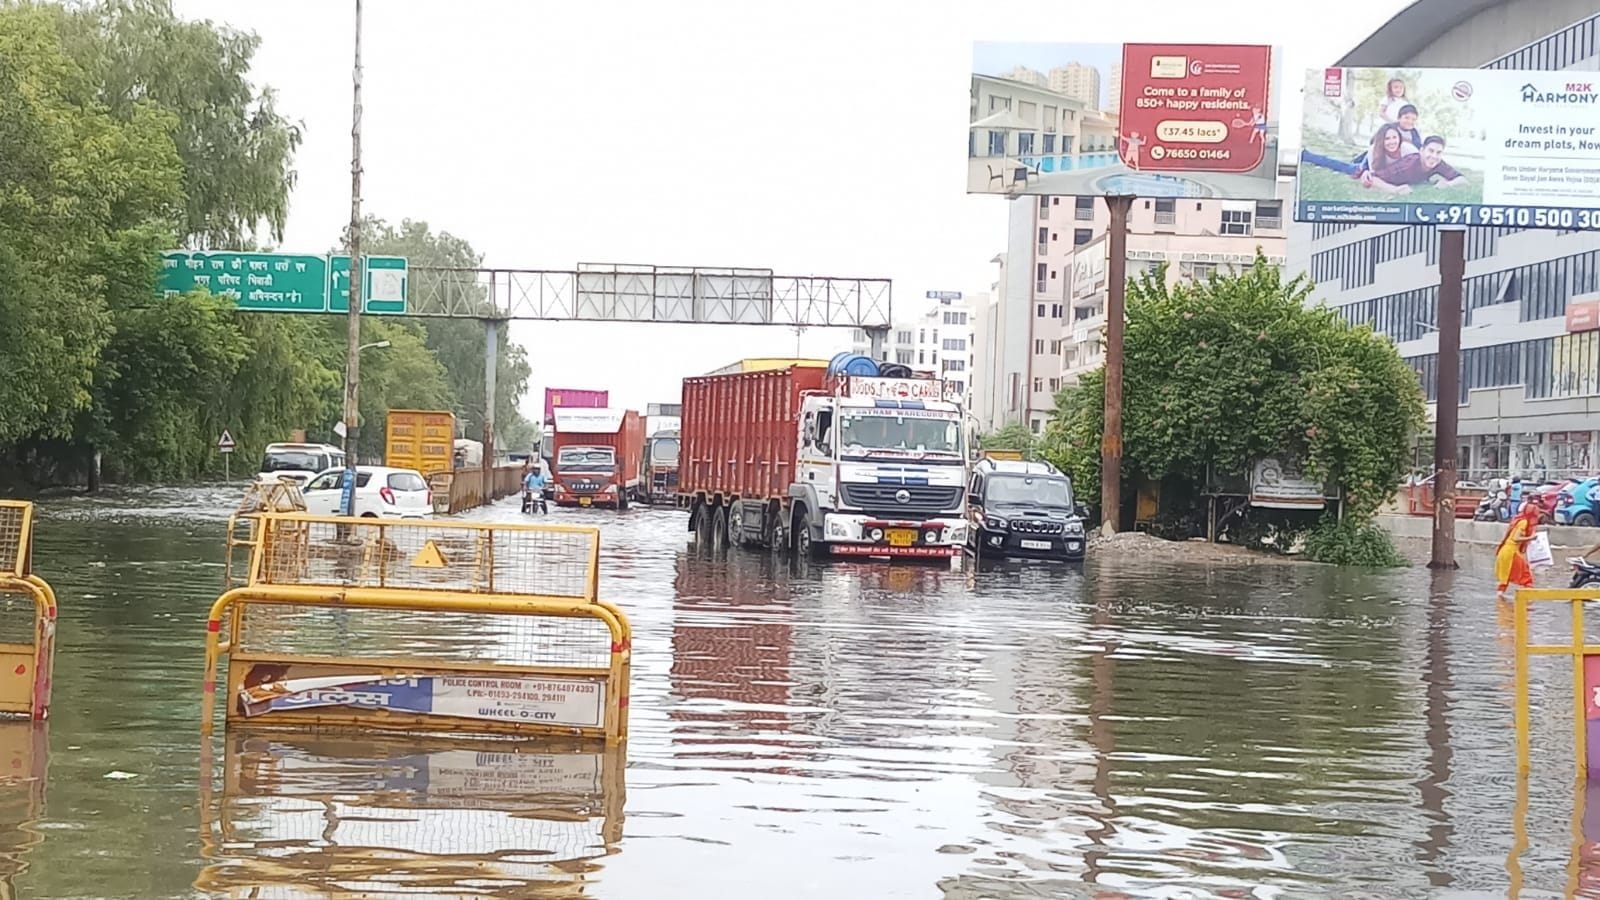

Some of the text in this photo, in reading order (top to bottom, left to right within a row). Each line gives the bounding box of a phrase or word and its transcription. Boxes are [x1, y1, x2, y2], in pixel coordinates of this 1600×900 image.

[1144, 87, 1246, 99] Come to a family of
[1566, 83, 1592, 92] M2K
[1522, 91, 1598, 103] HARMONY
[1137, 98, 1251, 110] 850+ happy residents.
[1519, 124, 1595, 136] Invest in your
[1505, 138, 1541, 148] dream
[1544, 139, 1575, 151] plots,
[1166, 148, 1197, 159] 76650
[1437, 206, 1472, 224] +91
[1480, 207, 1529, 226] 9510
[1534, 208, 1572, 227] 500
[443, 679, 466, 687] POLICE
[468, 680, 499, 688] CONTROL
[500, 681, 522, 689] ROOM
